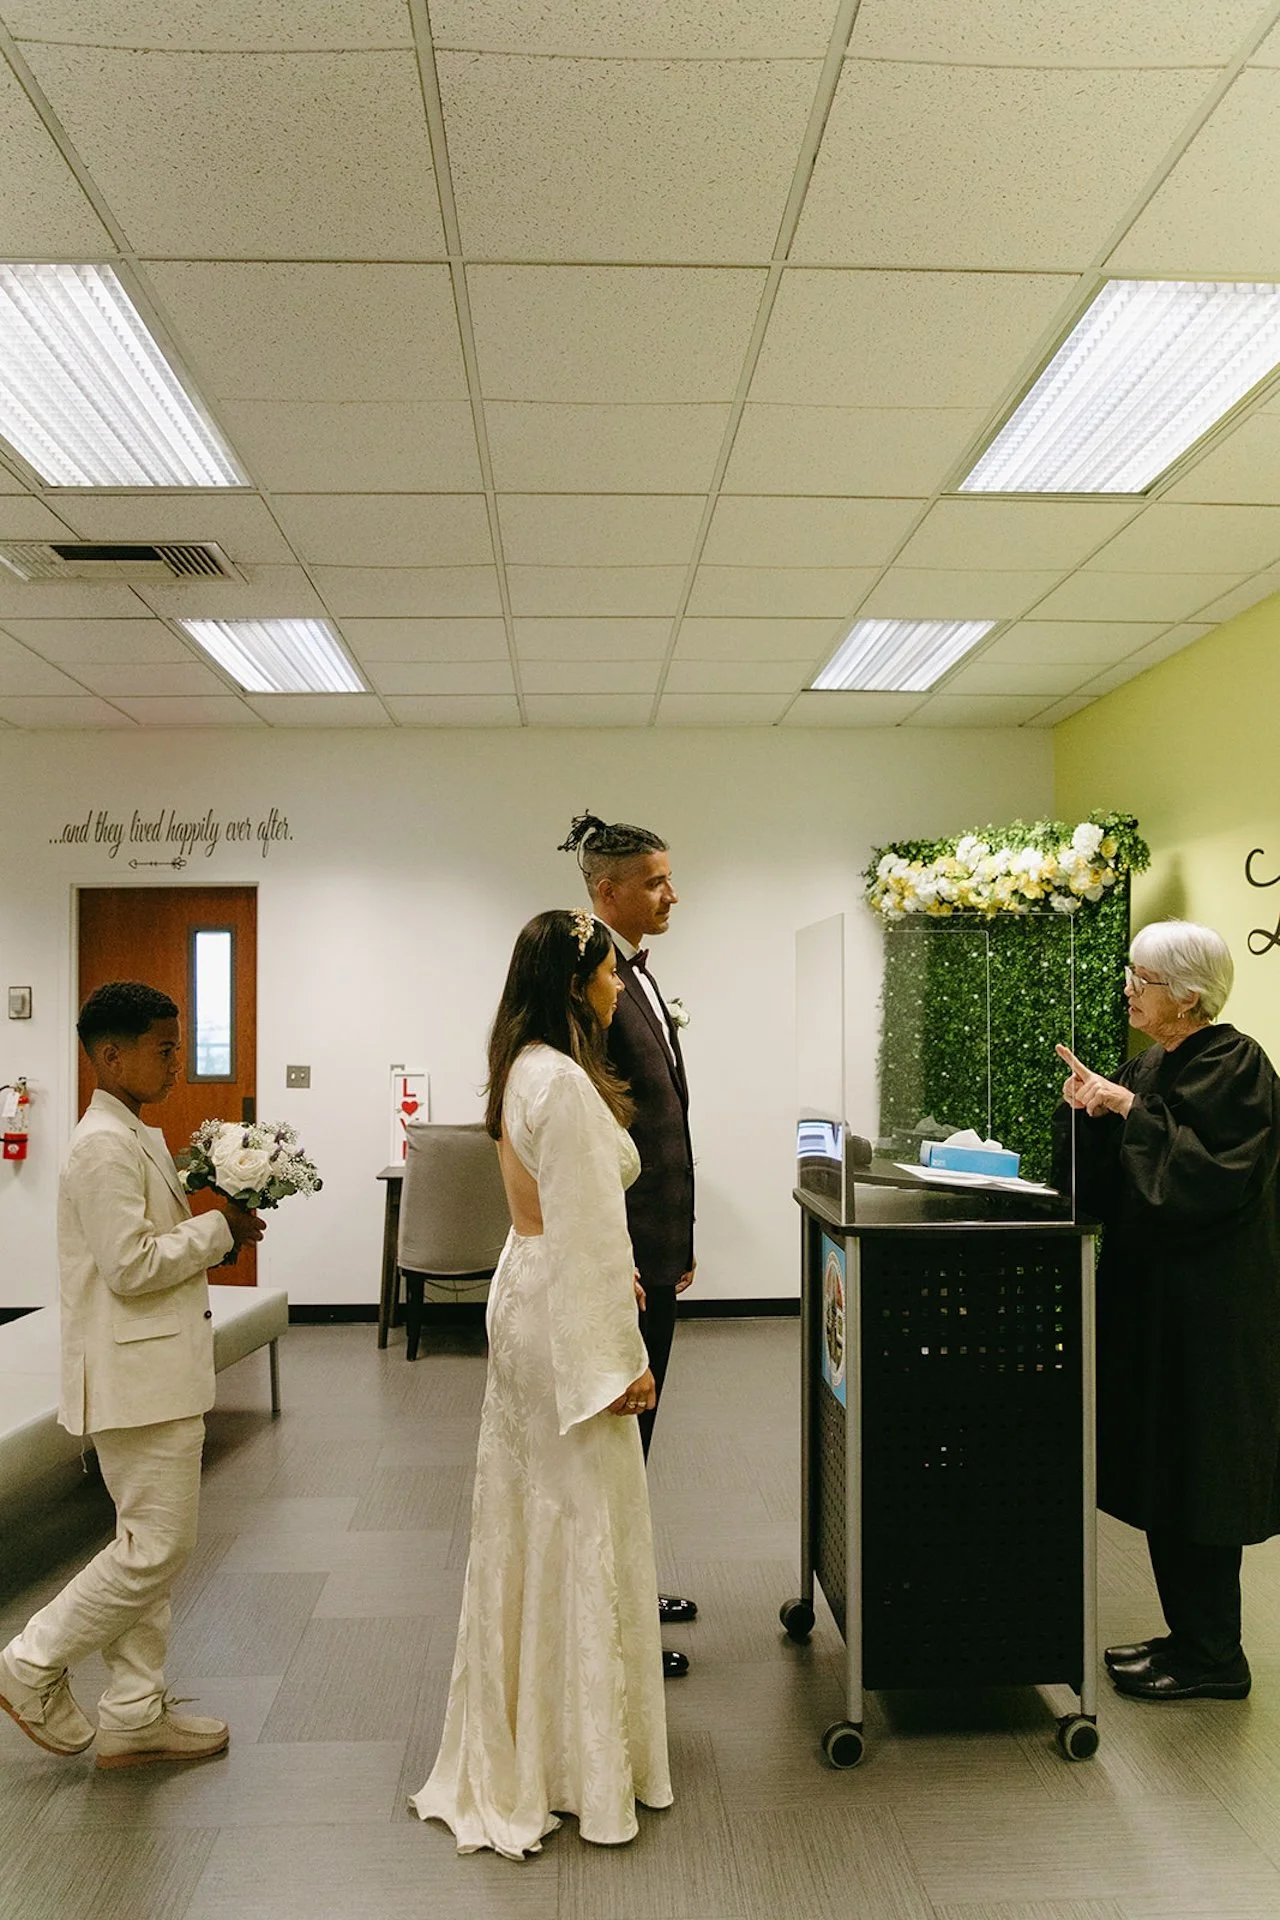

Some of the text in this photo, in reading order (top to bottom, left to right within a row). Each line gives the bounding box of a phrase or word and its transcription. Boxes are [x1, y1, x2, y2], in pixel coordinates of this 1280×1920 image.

[95, 810, 124, 859] they
[129, 809, 165, 844] lived
[165, 808, 220, 858] happily
[225, 816, 252, 842] ever
[256, 807, 294, 859] after.
